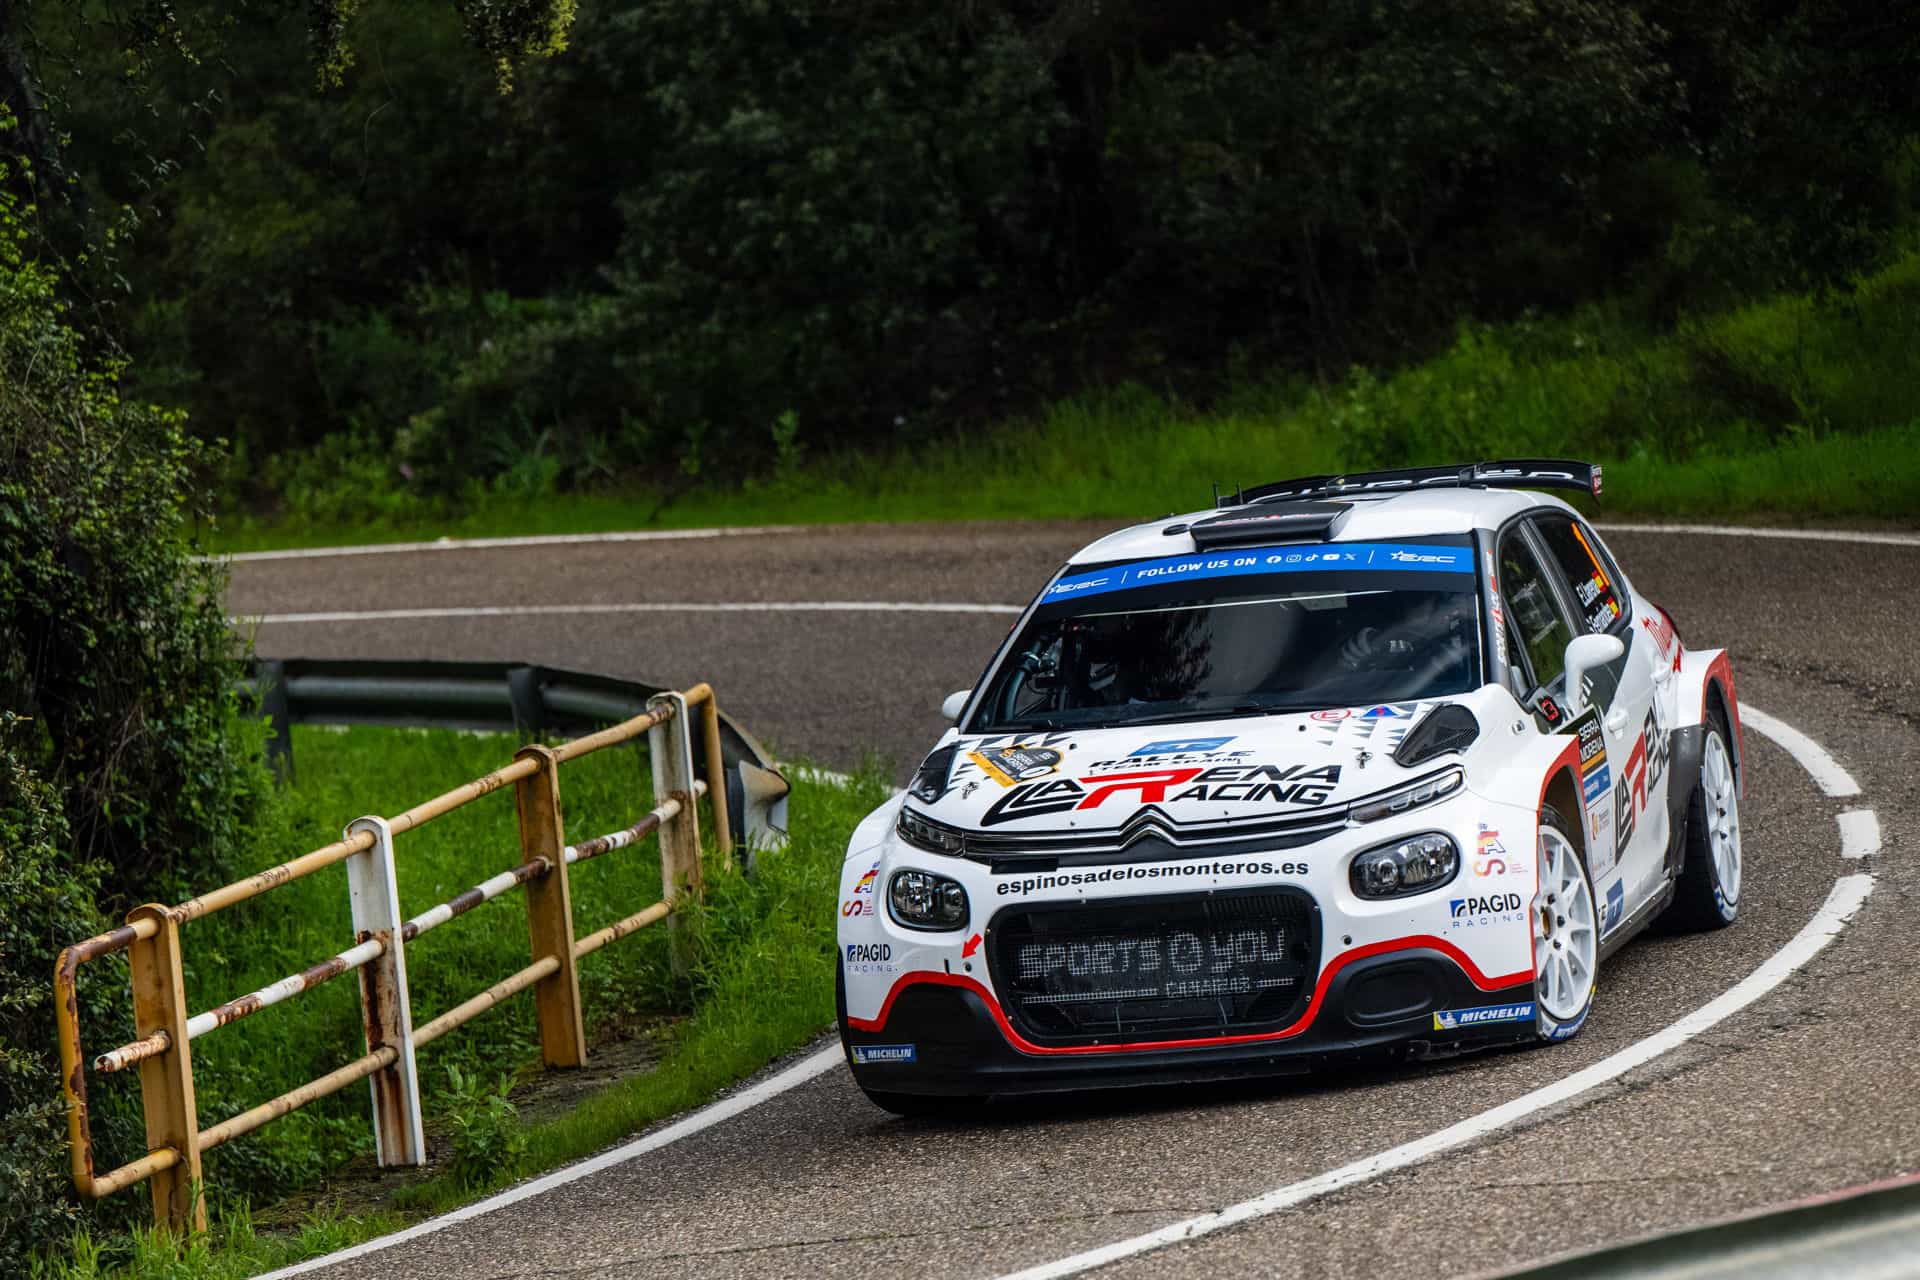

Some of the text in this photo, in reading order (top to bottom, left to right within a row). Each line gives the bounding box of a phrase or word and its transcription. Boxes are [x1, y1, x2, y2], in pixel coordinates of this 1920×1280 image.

[1137, 556, 1256, 579] FOLLOW US ON
[1088, 750, 1255, 768] RALLYE
[996, 861, 1309, 895] espinosadelosmonteros.es
[1469, 893, 1521, 915] PAGID
[1452, 913, 1524, 928] RACING
[857, 943, 892, 962] PAGID
[1019, 937, 1161, 979] SPORTS
[1460, 1005, 1532, 1023] MICHELIN
[867, 1047, 912, 1060] MICHELIN
